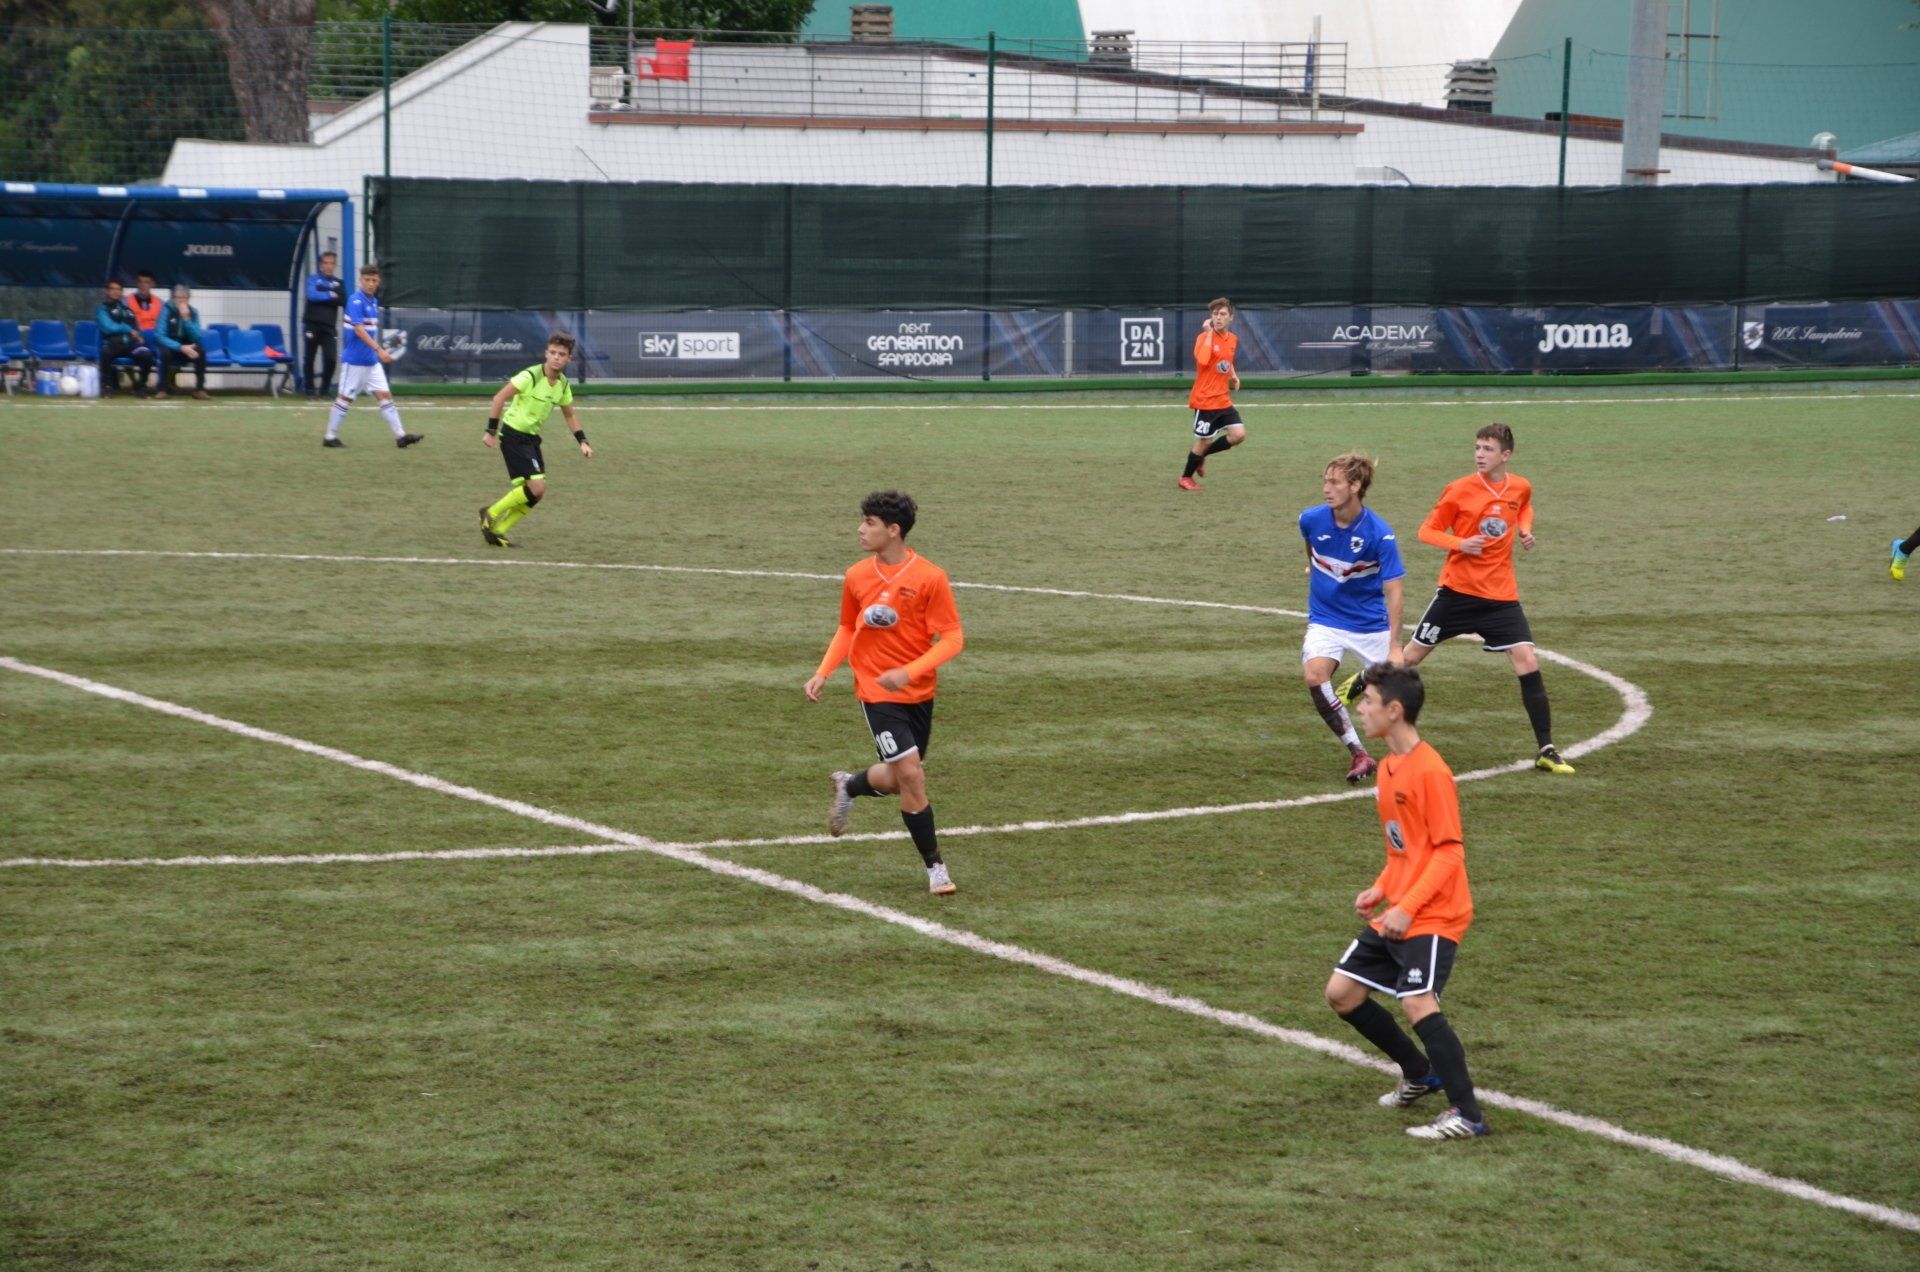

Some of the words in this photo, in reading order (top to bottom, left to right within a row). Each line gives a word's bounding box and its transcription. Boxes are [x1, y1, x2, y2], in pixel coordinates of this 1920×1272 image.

[1332, 325, 1429, 340] ACADEMY
[644, 334, 676, 356] sky
[683, 336, 735, 355] sport
[867, 335, 964, 351] GENERATION
[1419, 622, 1441, 643] 14
